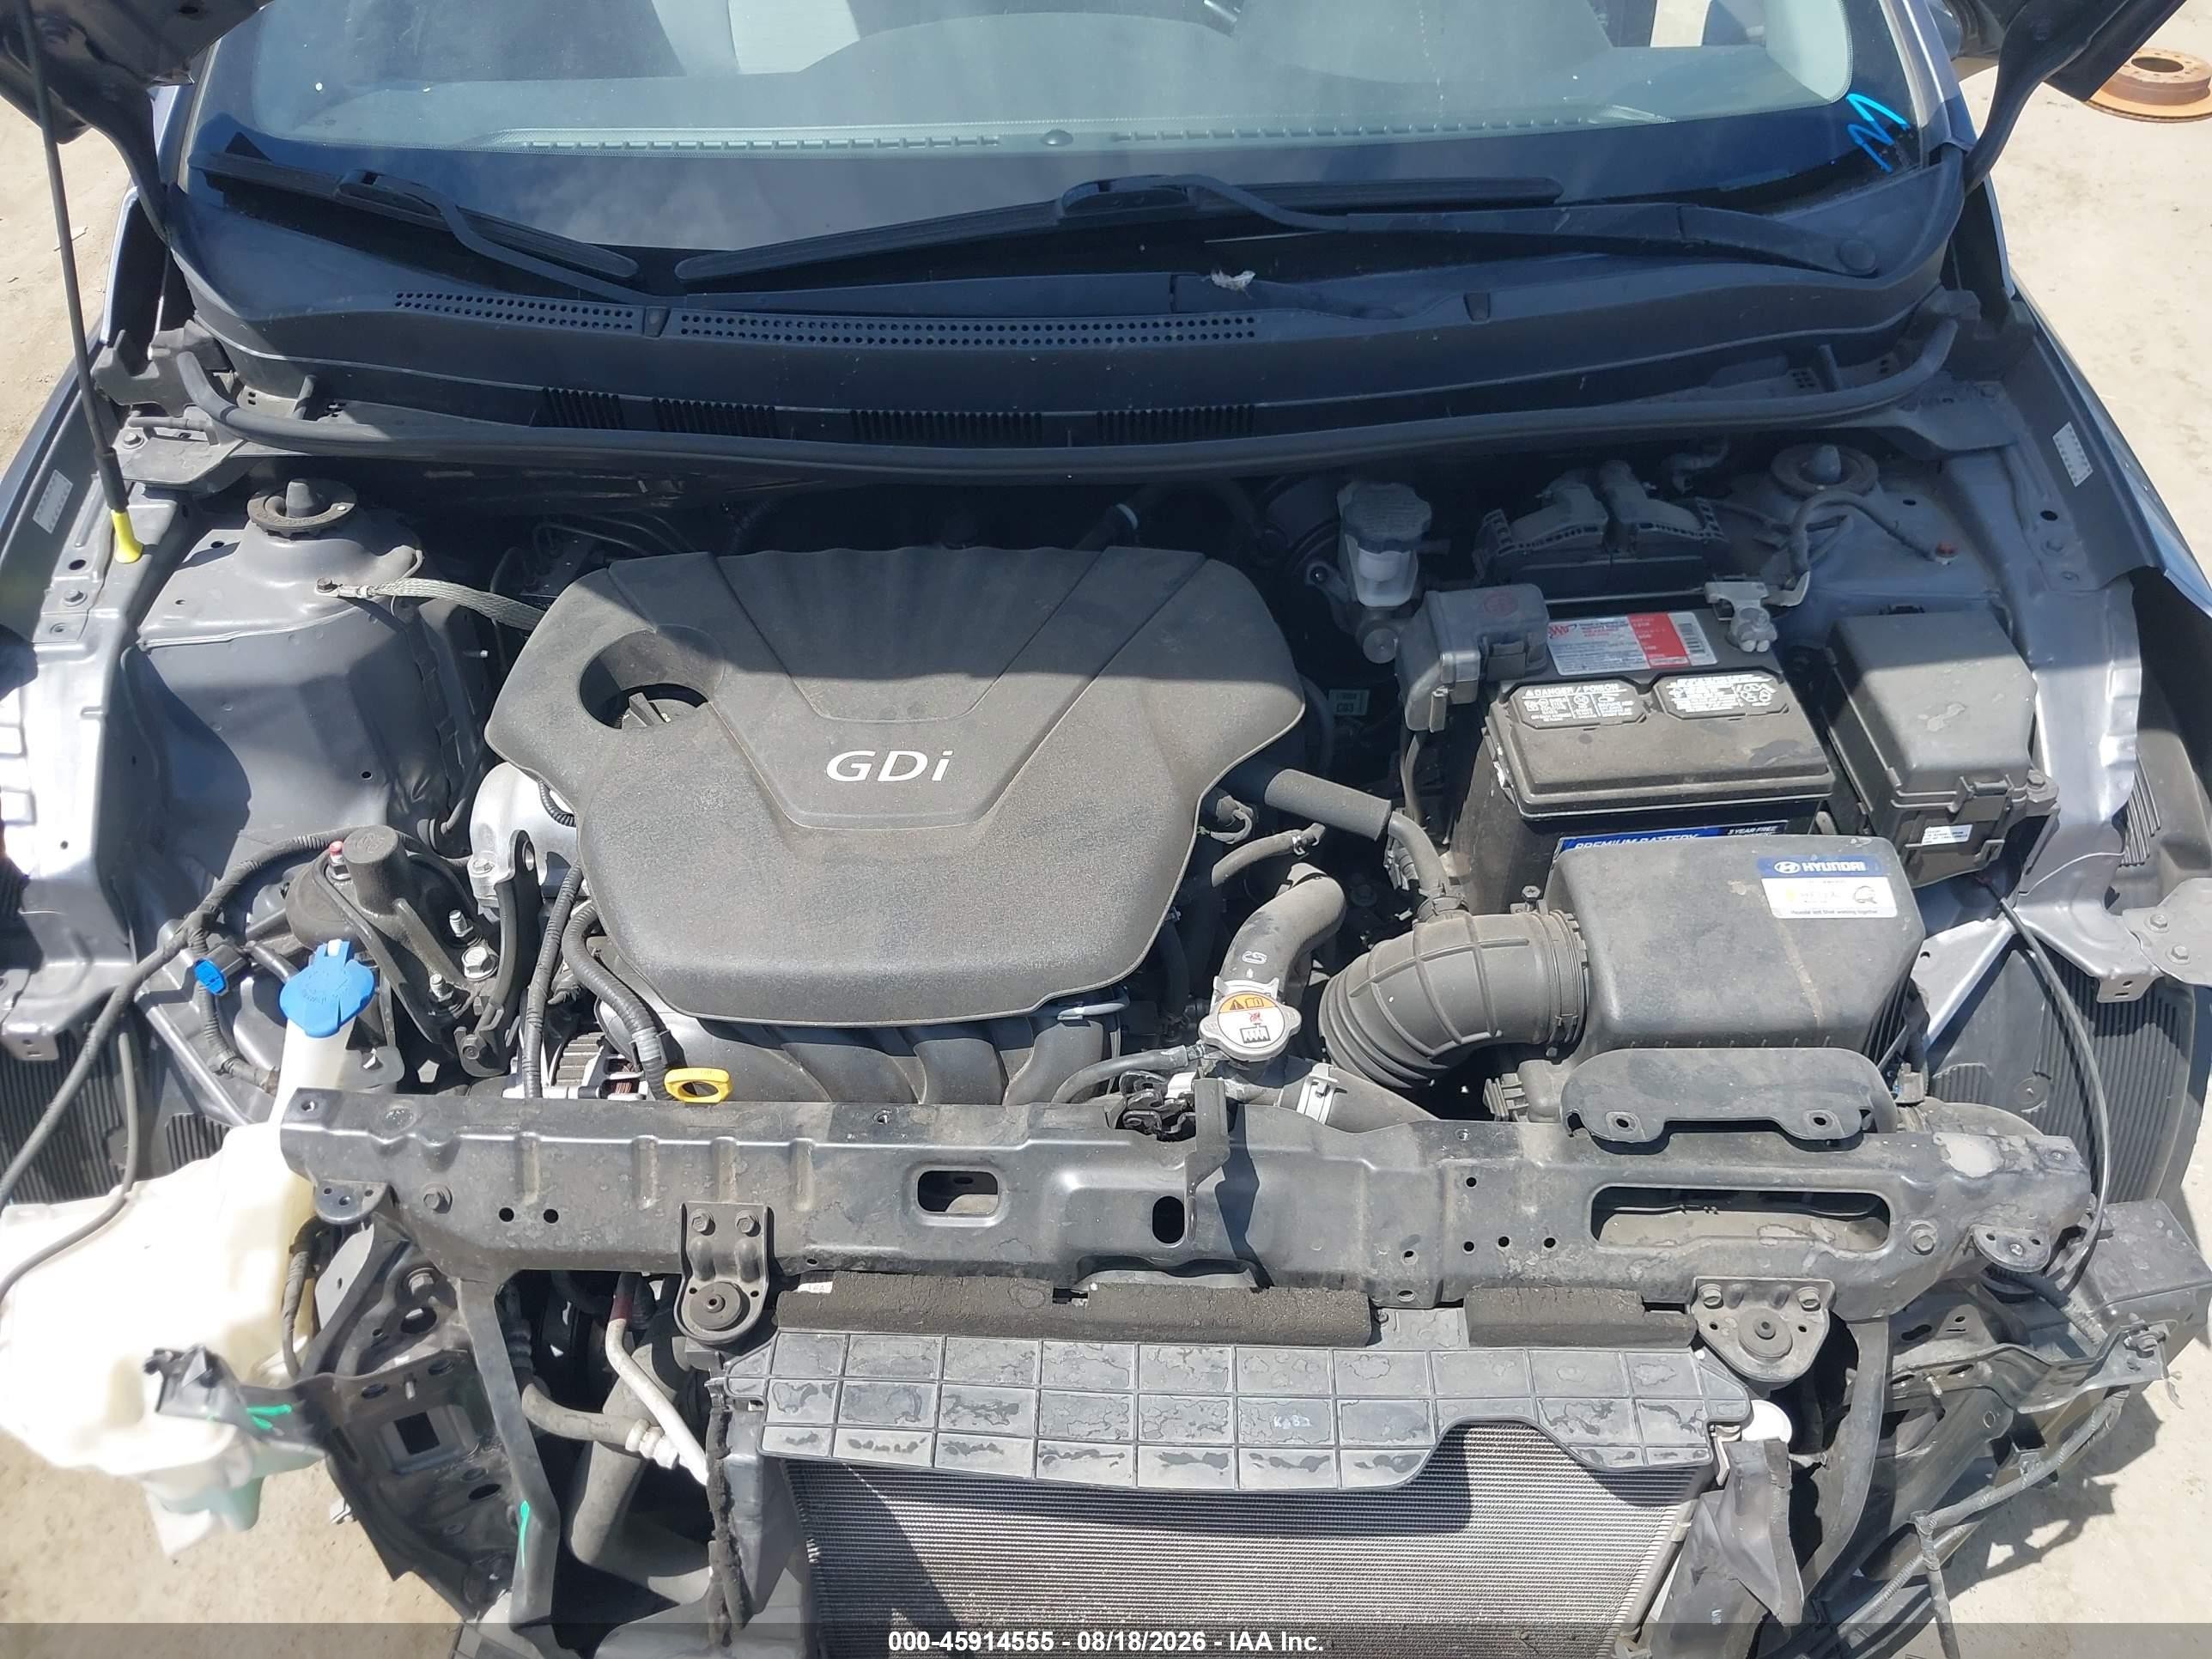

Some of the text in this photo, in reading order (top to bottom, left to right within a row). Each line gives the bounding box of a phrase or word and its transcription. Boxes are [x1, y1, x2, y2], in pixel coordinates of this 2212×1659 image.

[1534, 687, 1573, 696] DANGER
[1583, 684, 1620, 693] POISON
[826, 750, 954, 782] GDi
[1802, 861, 1867, 872] HYUNDAI
